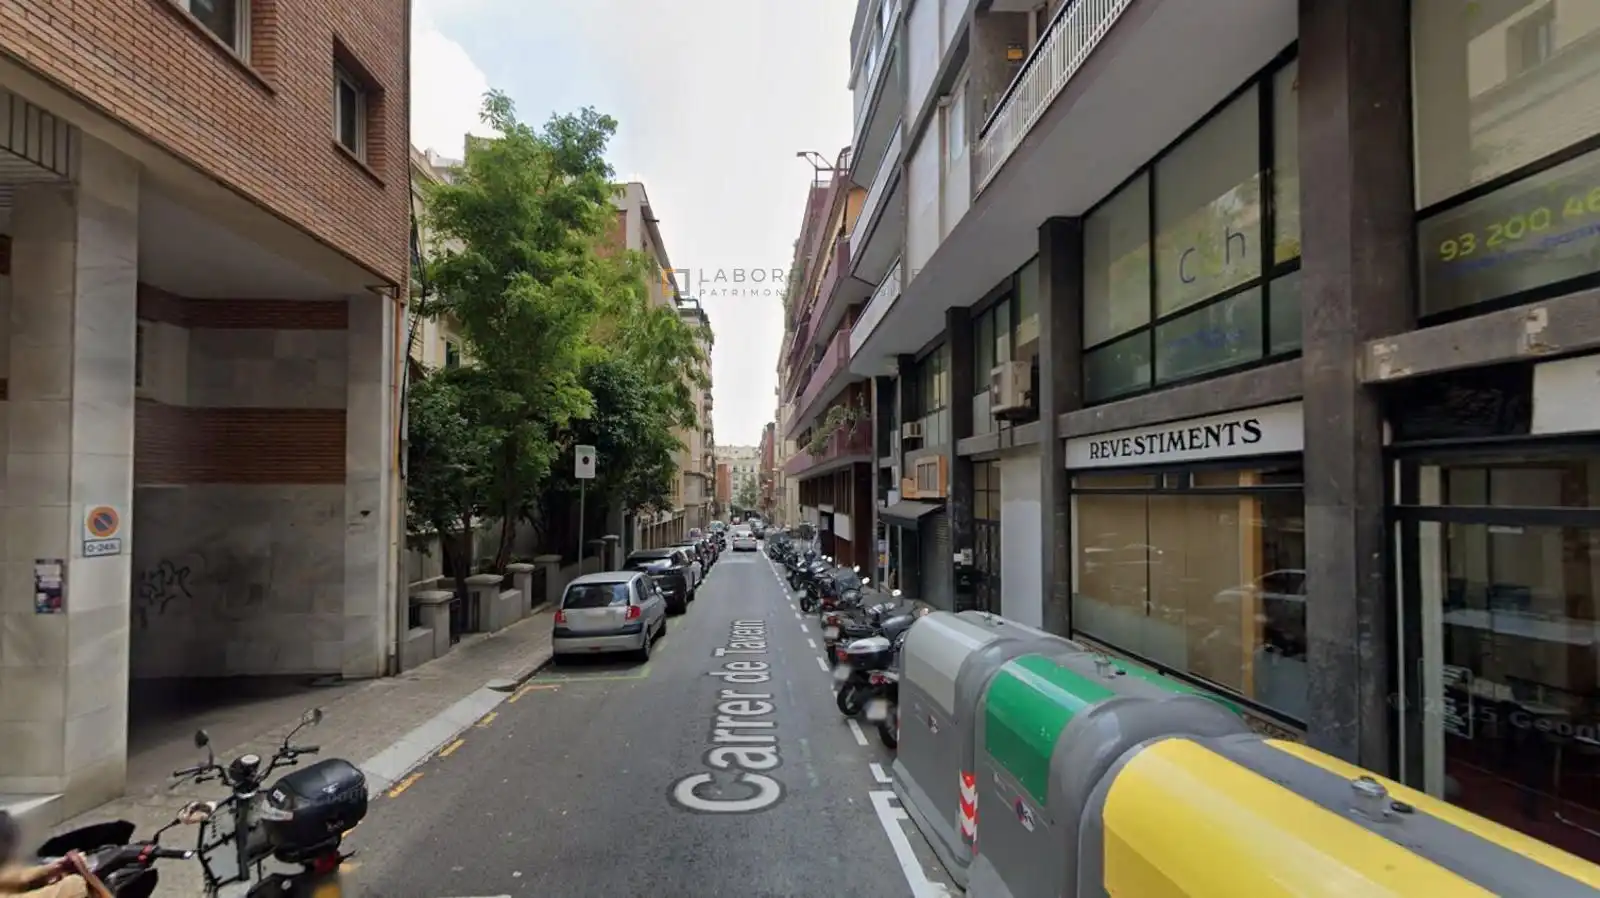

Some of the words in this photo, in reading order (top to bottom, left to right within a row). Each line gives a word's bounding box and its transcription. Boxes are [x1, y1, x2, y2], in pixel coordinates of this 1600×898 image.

[1440, 232, 1476, 262] 93
[1485, 207, 1551, 248] 200
[1089, 418, 1262, 460] REVESTIMENTS
